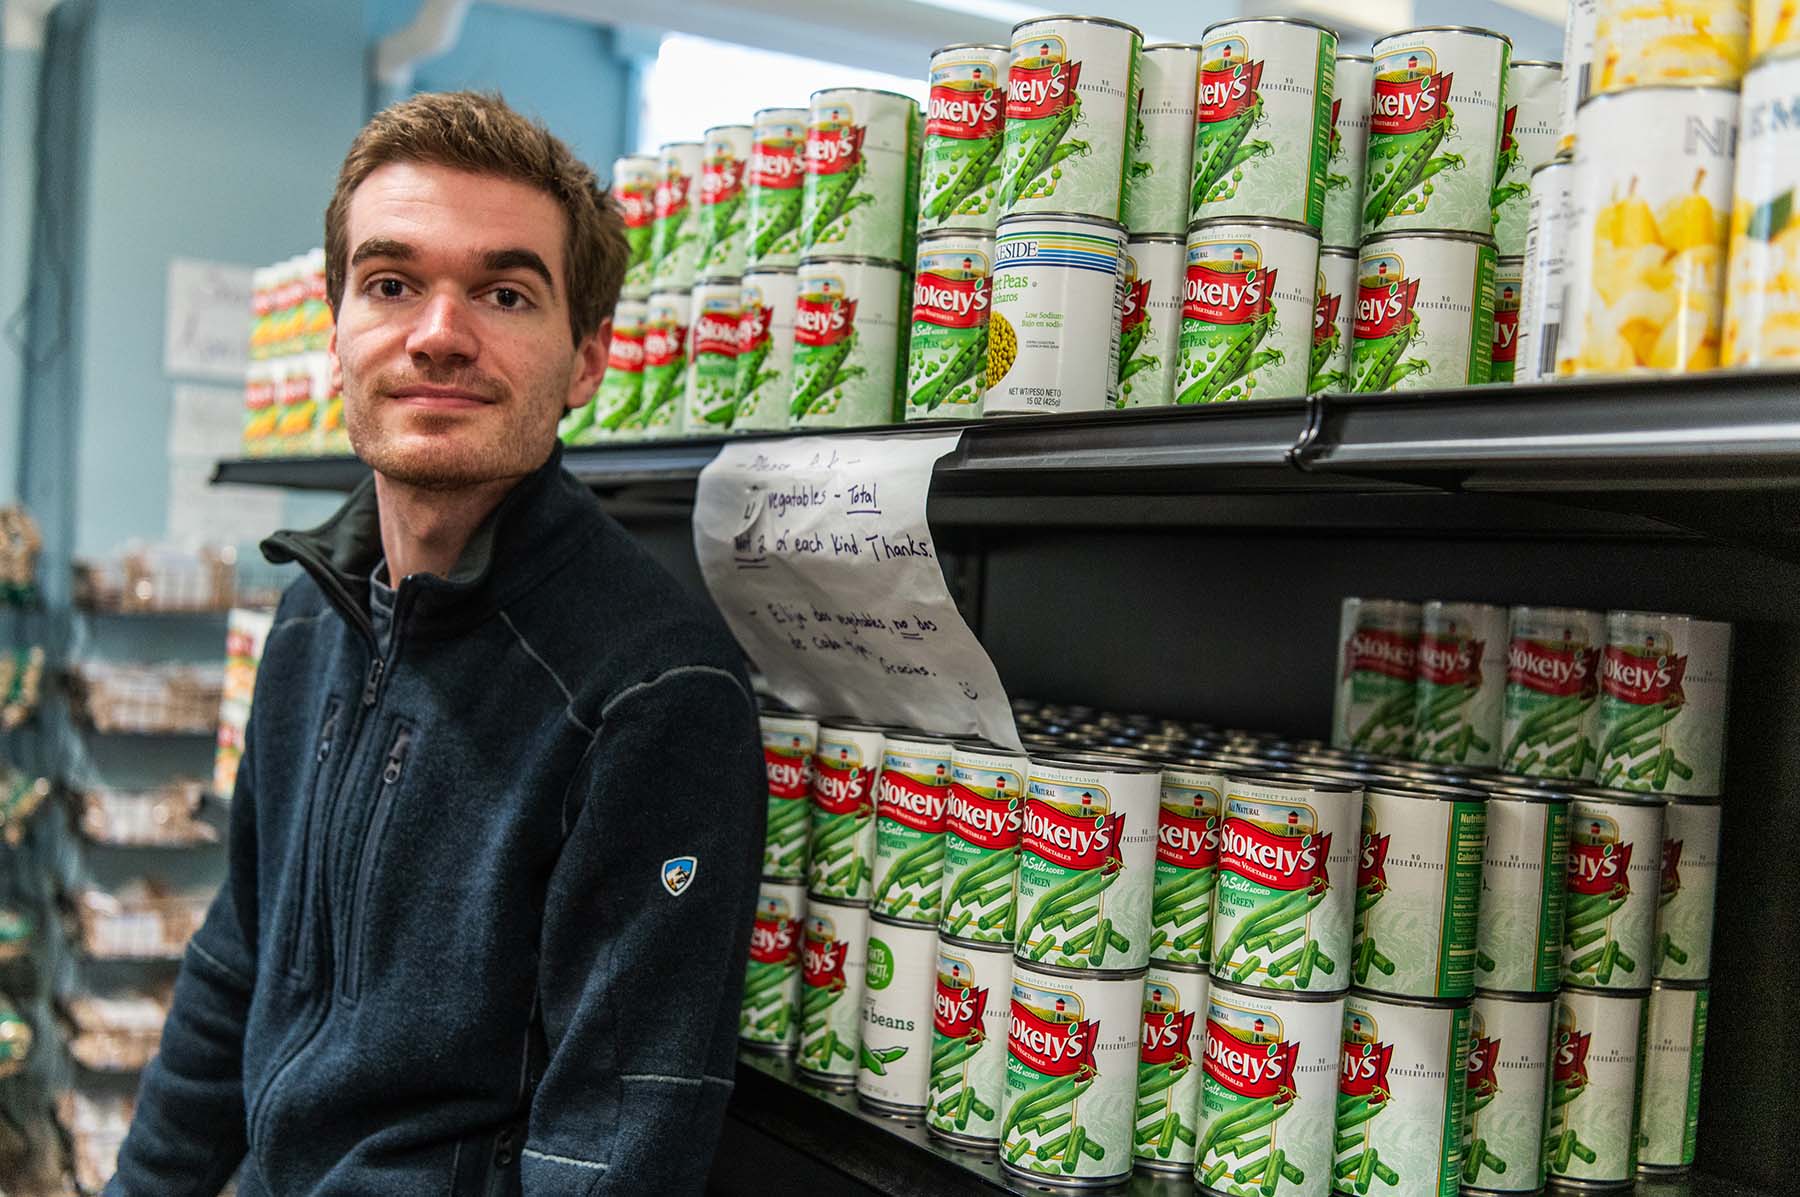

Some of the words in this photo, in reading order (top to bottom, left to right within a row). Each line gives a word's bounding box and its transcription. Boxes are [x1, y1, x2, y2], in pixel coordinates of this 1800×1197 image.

[1199, 64, 1247, 108] kely's
[1261, 82, 1313, 96] PRESERVATIVES
[1285, 77, 1294, 85] NO
[929, 89, 998, 127] okely's
[1370, 75, 1437, 120] okely's
[1004, 273, 1029, 290] Peas
[1183, 270, 1261, 311] tokely's
[1356, 281, 1402, 325] kely's
[1417, 302, 1471, 313] PRESERVATIVES
[1026, 397, 1033, 405] 15
[1034, 397, 1042, 405] OZ
[1046, 388, 1061, 397] NETO
[848, 483, 877, 508] Total
[795, 530, 824, 551] each
[865, 534, 933, 561] Thanks.
[1603, 655, 1673, 692] okely's
[878, 775, 949, 822] Stokely
[1236, 803, 1260, 816] NATURAL
[1023, 805, 1110, 856] Stokely's
[1159, 816, 1220, 856] kely's
[1039, 842, 1072, 861] VEGETABLES
[1159, 848, 1184, 860] ETABLES
[1220, 824, 1316, 877] Stokely's
[1028, 856, 1047, 871] Salt
[1046, 867, 1065, 875] ADDED
[1241, 861, 1277, 882] VEGETABLES
[1387, 858, 1444, 870] PRESERVATIVES
[1568, 843, 1618, 882] ely's
[1029, 872, 1051, 888] GREEN
[1220, 874, 1229, 888] No
[1228, 876, 1249, 892] Salt
[1249, 888, 1270, 896] ADDED
[1219, 901, 1236, 918] BEANS
[1230, 893, 1255, 909] GREEN
[1248, 1001, 1273, 1010] FLAVOR
[871, 1007, 915, 1032] beans
[1016, 1044, 1046, 1066] VEGETABLES
[1206, 1029, 1282, 1084] tokely's
[1008, 1058, 1023, 1075] Salt
[1022, 1071, 1040, 1080] ADDED
[1212, 1063, 1244, 1088] VEGETABLES
[1390, 1068, 1445, 1079] PRESERVATIVES
[1205, 1080, 1219, 1096] Salt
